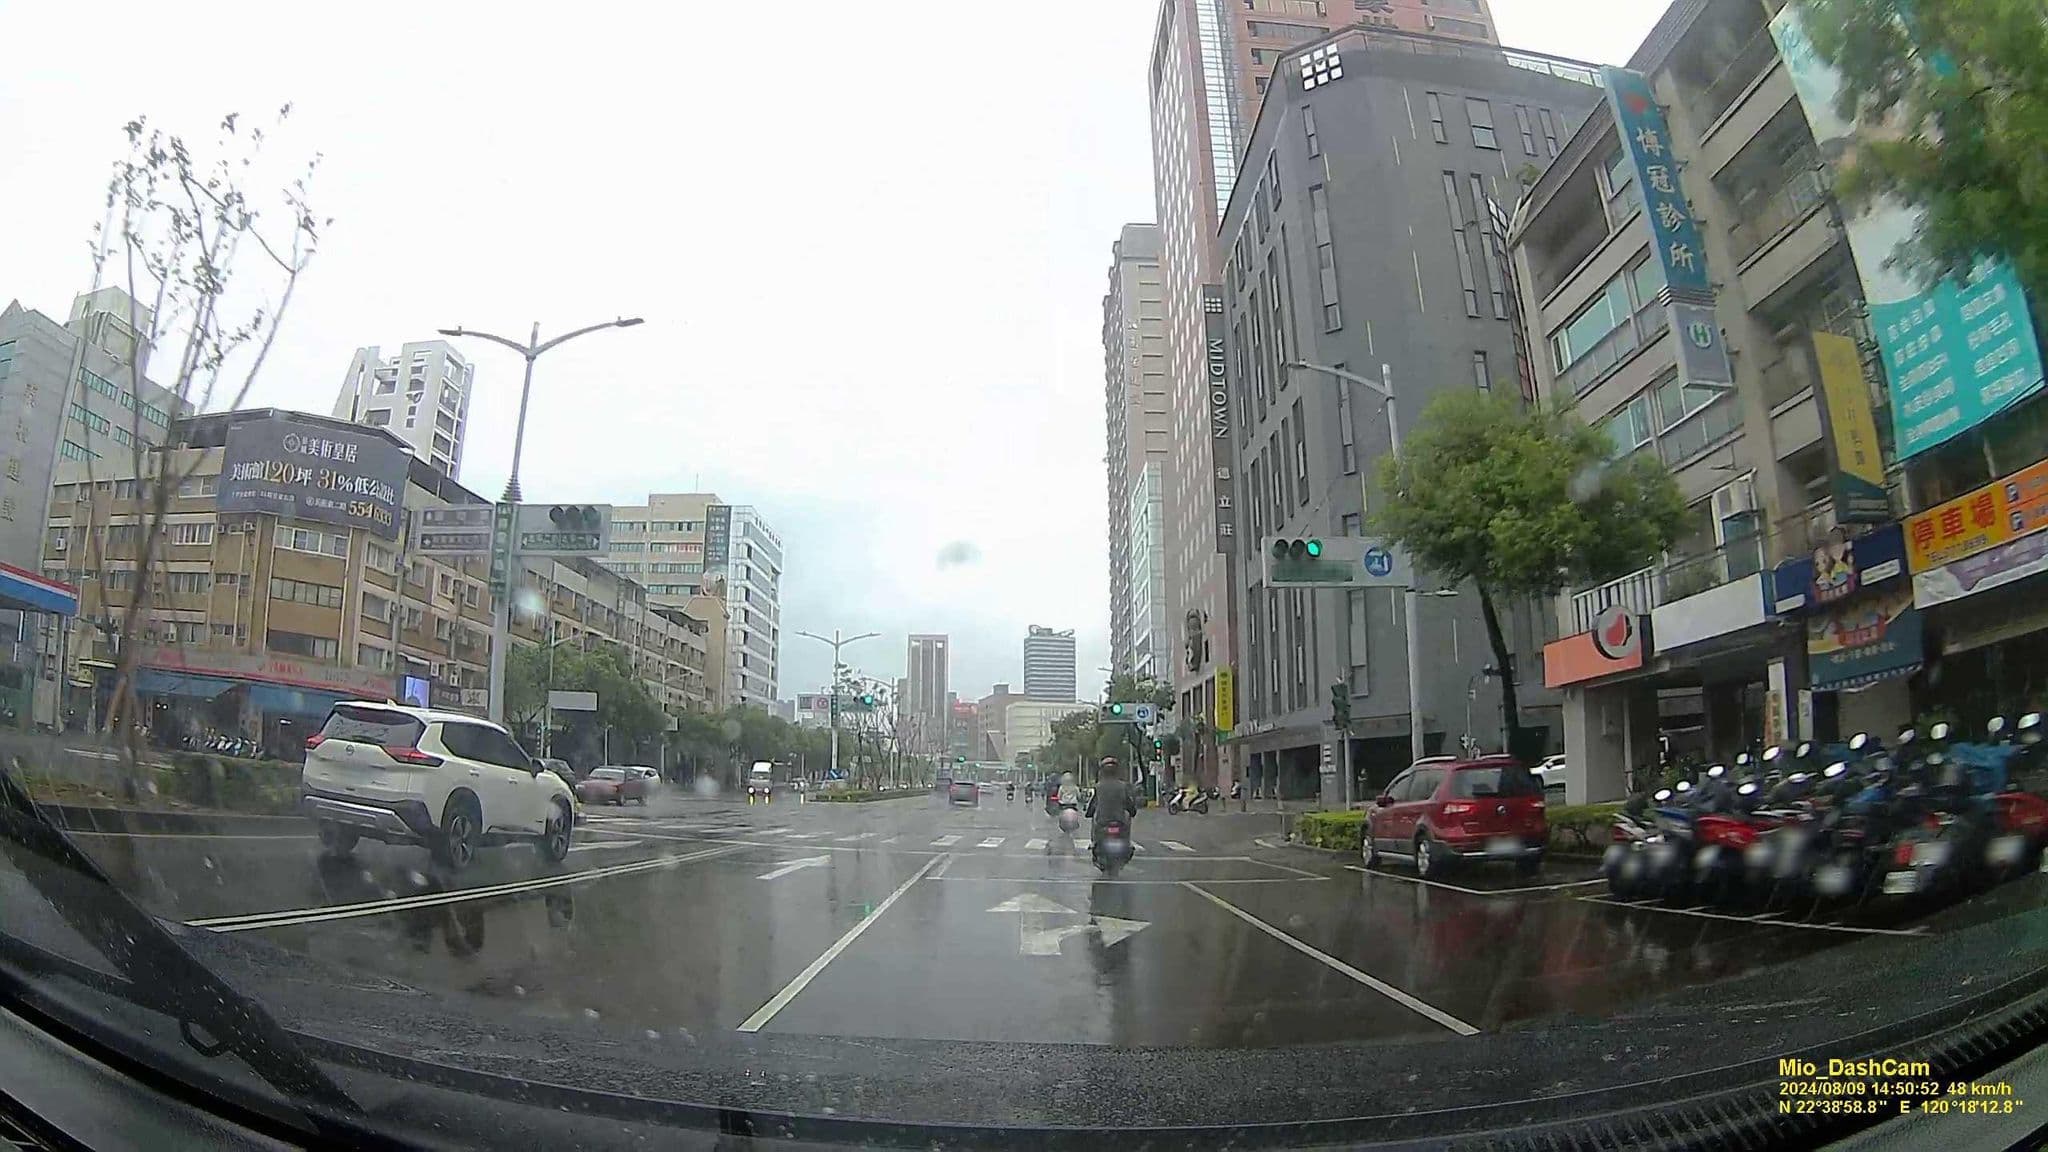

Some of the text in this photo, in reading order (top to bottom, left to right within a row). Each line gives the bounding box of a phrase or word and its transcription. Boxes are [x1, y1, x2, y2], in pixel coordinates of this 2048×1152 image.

[1636, 127, 1695, 273] 博冠診所
[1208, 338, 1231, 439] MIDTOWN
[308, 438, 358, 464] 美術皇居
[1912, 491, 1996, 550] 停車場
